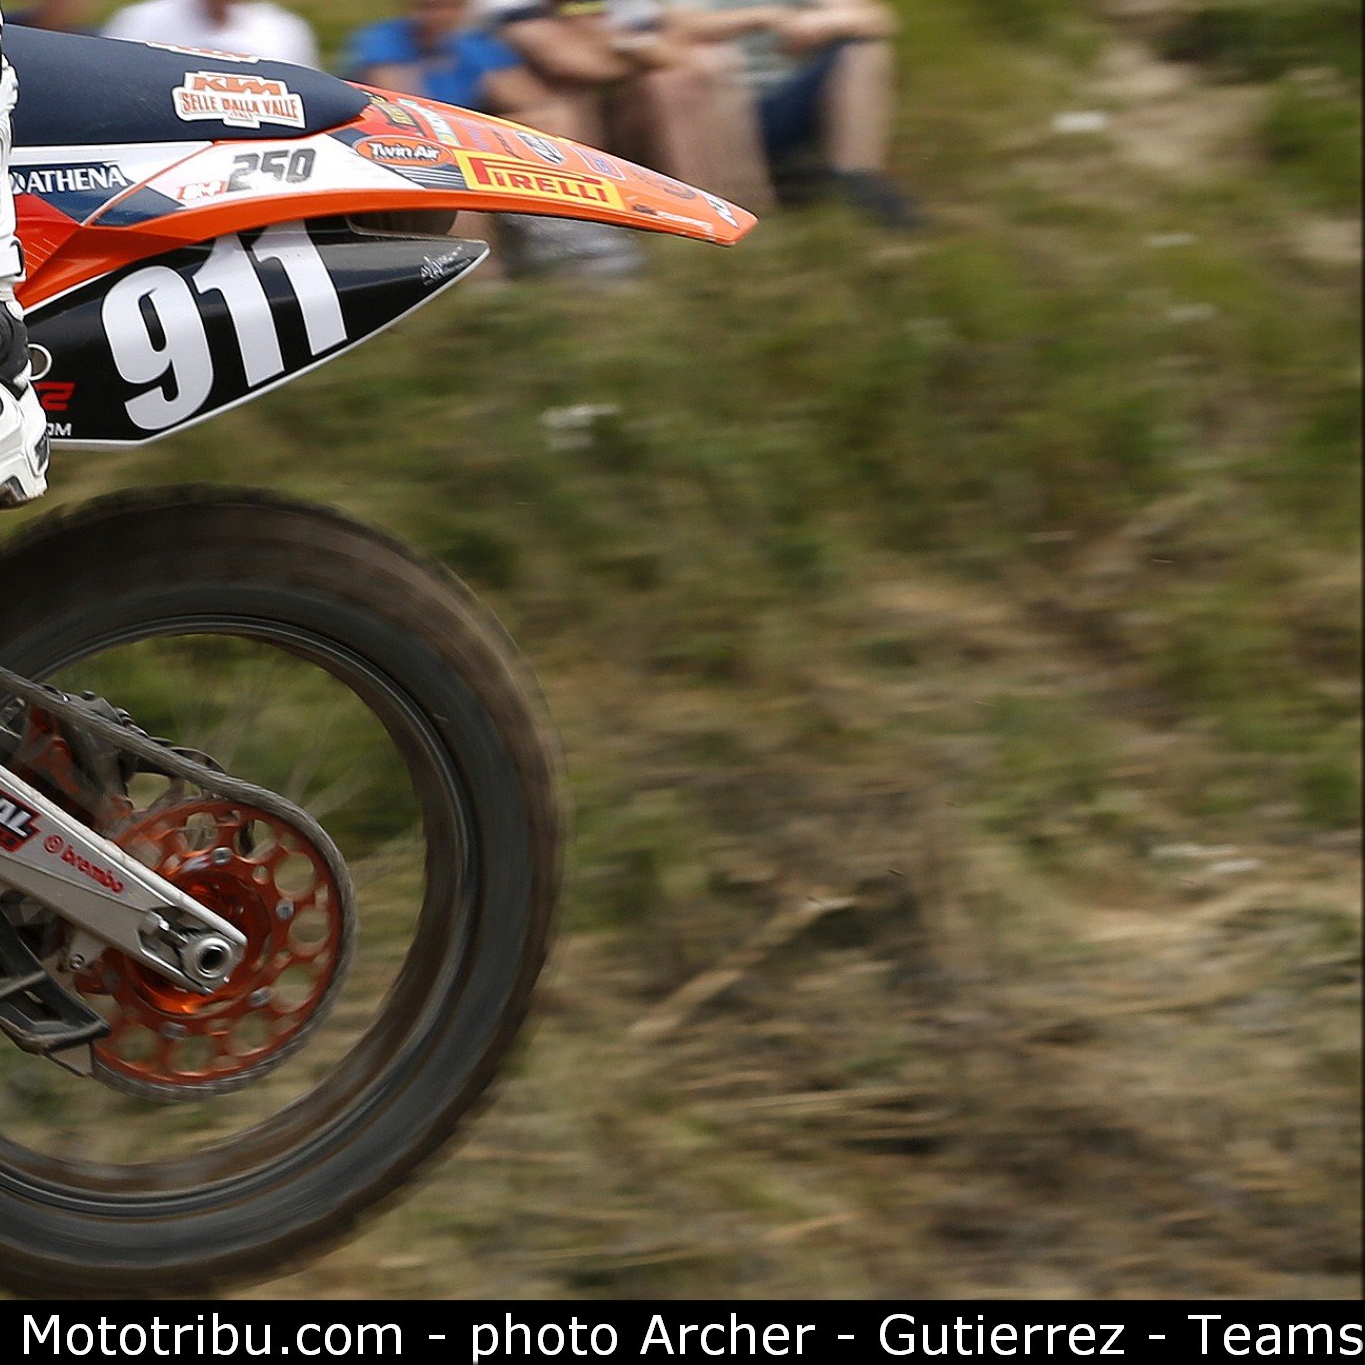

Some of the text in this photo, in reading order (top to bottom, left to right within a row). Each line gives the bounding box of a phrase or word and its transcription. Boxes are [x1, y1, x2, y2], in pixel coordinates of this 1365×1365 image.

[180, 91, 218, 112] SELLE
[263, 99, 300, 120] VALLE
[192, 75, 282, 97] KTM
[226, 148, 317, 193] 250
[368, 142, 441, 161] Twin Air
[26, 160, 128, 194] ATHENA
[467, 156, 609, 204] PIRELLI
[100, 221, 350, 432] 911
[61, 844, 124, 894] brembo
